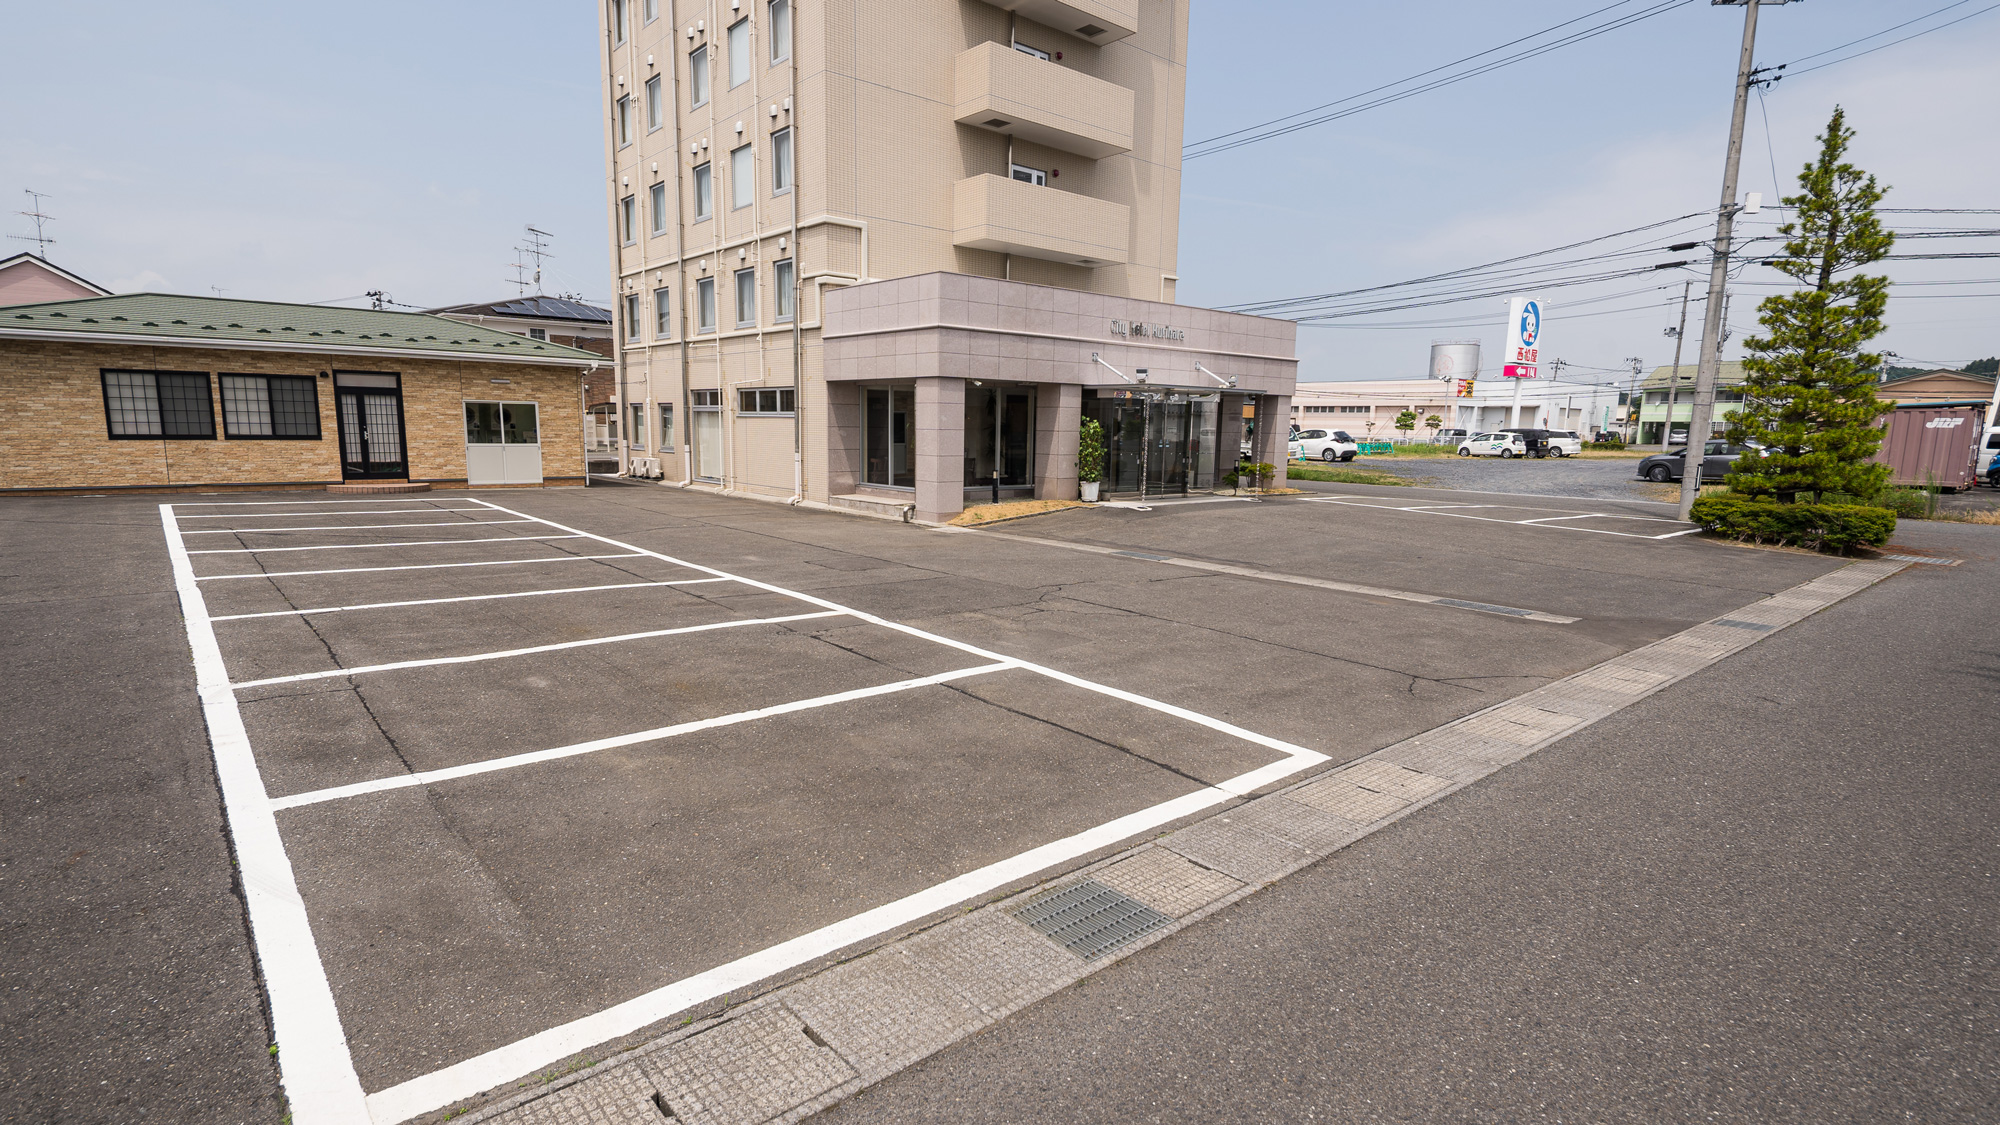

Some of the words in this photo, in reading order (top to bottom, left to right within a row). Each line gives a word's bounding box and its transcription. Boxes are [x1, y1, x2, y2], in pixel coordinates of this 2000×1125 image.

[1110, 319, 1127, 336] City
[1129, 321, 1151, 337] Hotel
[1152, 323, 1185, 341] Kurihara
[1516, 347, 1538, 363] 西松屋
[1527, 367, 1536, 378] IN
